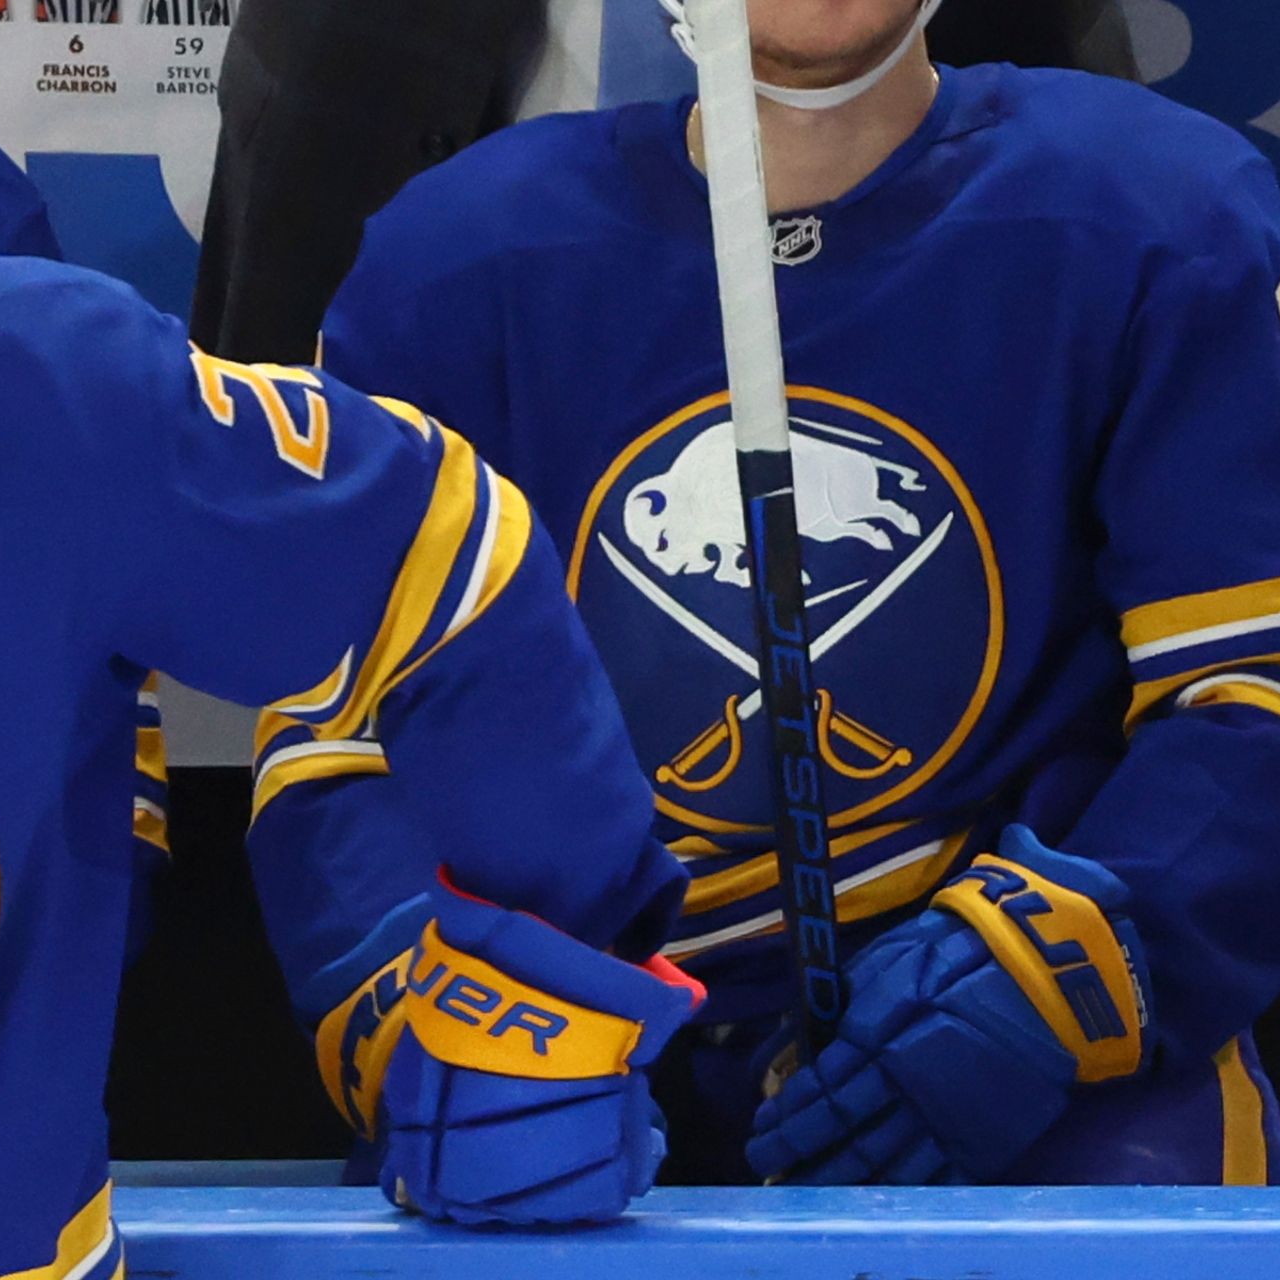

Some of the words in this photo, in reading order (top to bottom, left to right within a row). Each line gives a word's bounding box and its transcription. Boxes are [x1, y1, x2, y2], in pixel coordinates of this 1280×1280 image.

[69, 34, 85, 54] 6
[174, 37, 204, 55] 59
[42, 64, 110, 79] FRANCIS
[167, 66, 212, 80] STEVE
[36, 79, 117, 94] CHARRON
[765, 591, 841, 1020] JETSPEED
